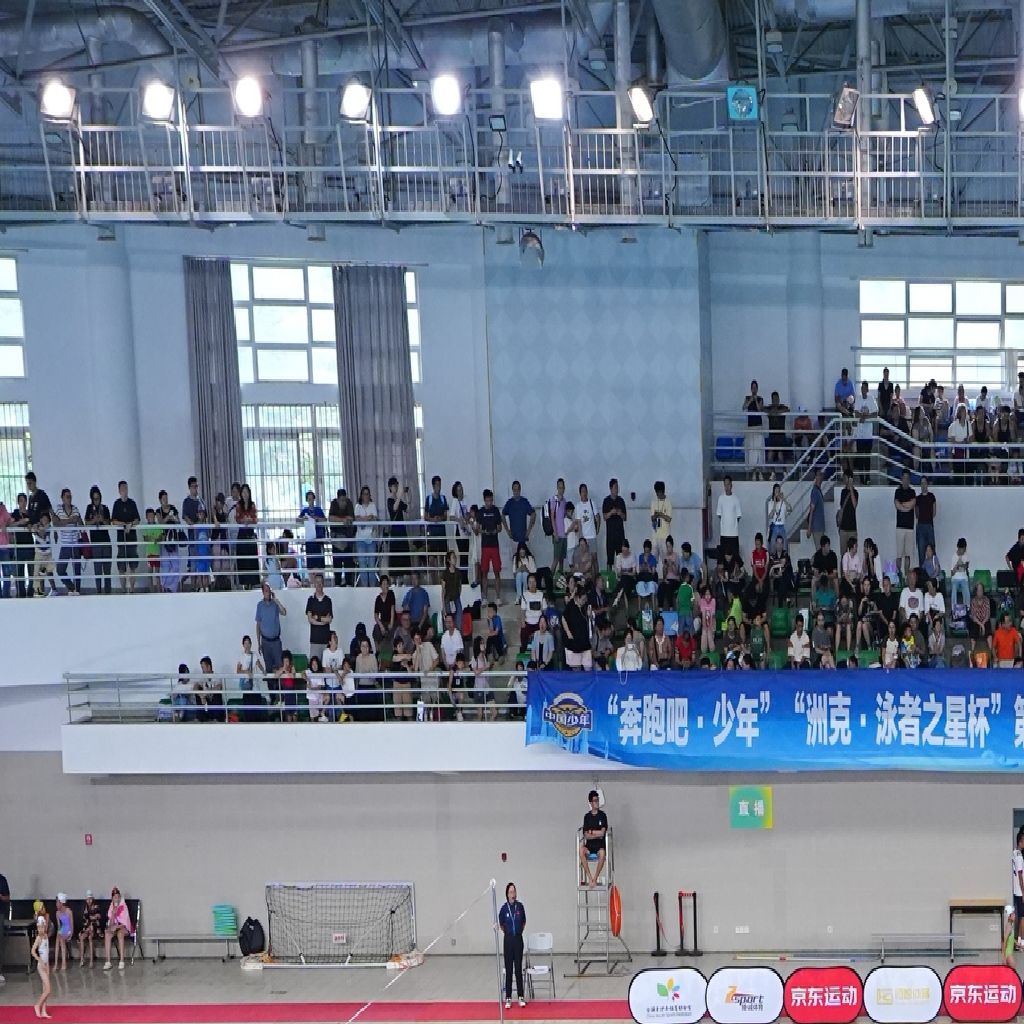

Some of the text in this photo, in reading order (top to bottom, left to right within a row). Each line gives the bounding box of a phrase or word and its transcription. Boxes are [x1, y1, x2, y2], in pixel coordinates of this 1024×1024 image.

[738, 799, 765, 816] 直播
[790, 985, 858, 1007] 京东运动
[949, 984, 1017, 1005] 京东运动
